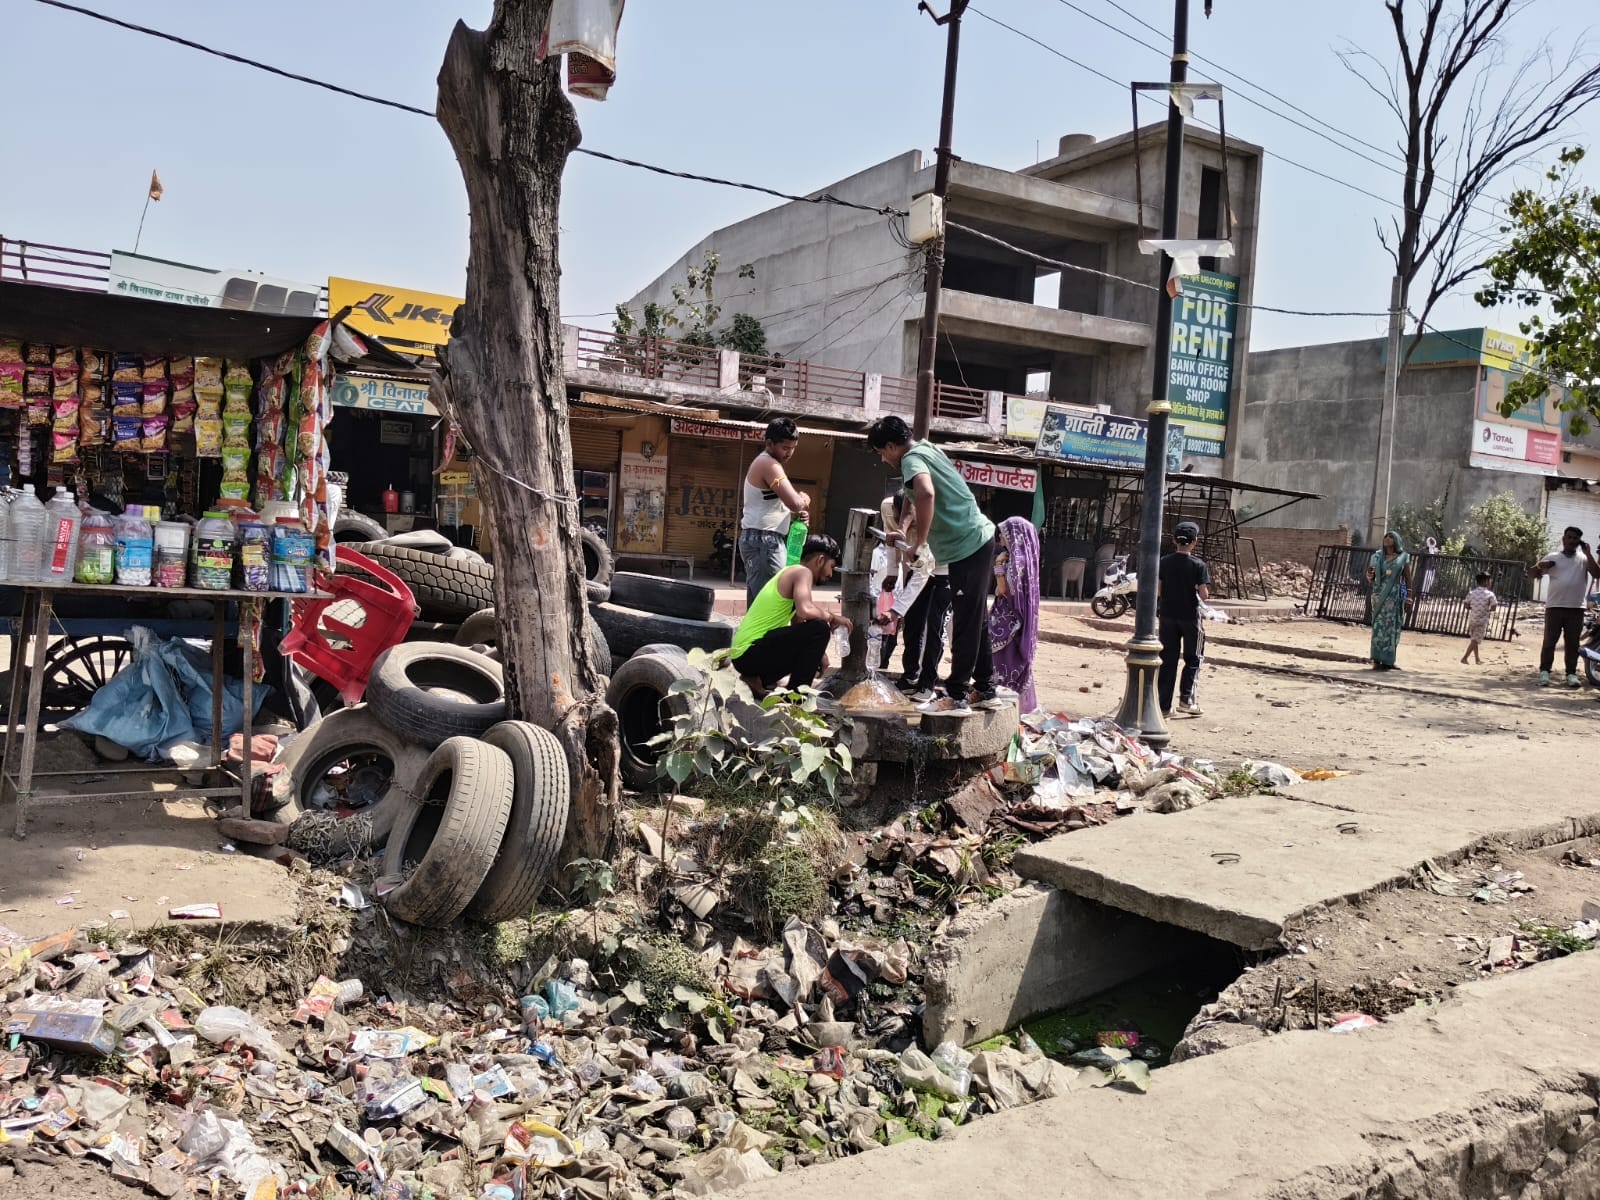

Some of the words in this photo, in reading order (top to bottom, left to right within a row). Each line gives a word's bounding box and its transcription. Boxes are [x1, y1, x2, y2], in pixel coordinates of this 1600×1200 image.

[117, 280, 127, 291] श्री
[130, 282, 162, 297] विनायक
[1181, 290, 1228, 328] FOR
[1172, 322, 1233, 361] RENT
[1170, 358, 1196, 374] BANK
[1197, 362, 1230, 380] OFFICE
[361, 380, 377, 397] श्री
[1170, 371, 1199, 388] SHOW
[1200, 376, 1227, 393] ROOM
[369, 398, 423, 412] CEAT
[1185, 388, 1211, 404] SHOP
[1492, 433, 1514, 445] TOTAL
[964, 463, 993, 482] आटो
[675, 485, 737, 515] JAYP
[693, 505, 738, 518] CEME
